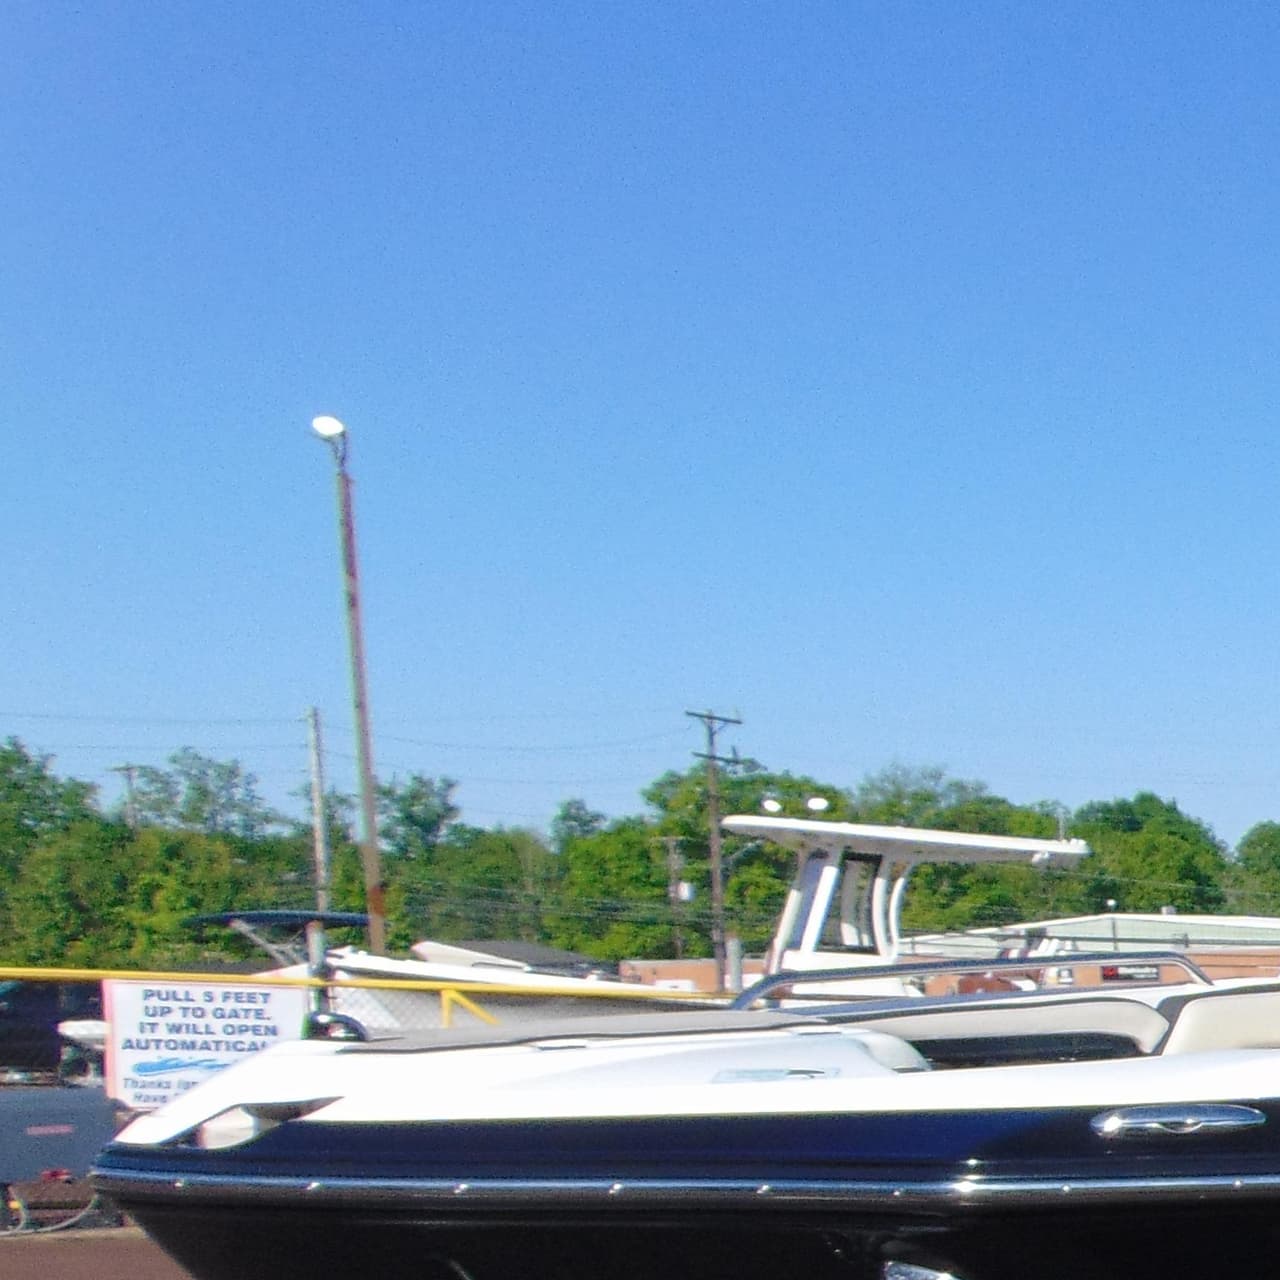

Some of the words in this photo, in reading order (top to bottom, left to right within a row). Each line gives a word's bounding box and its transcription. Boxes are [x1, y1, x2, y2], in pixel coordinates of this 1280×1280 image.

[143, 989, 195, 1003] PULL
[221, 991, 271, 1004] FEET
[144, 1005, 172, 1018] UP
[179, 1006, 205, 1019] TO
[212, 1007, 272, 1021] GATE.
[139, 1022, 159, 1034] IT
[165, 1022, 216, 1035] WILL
[222, 1024, 278, 1037] OPEN
